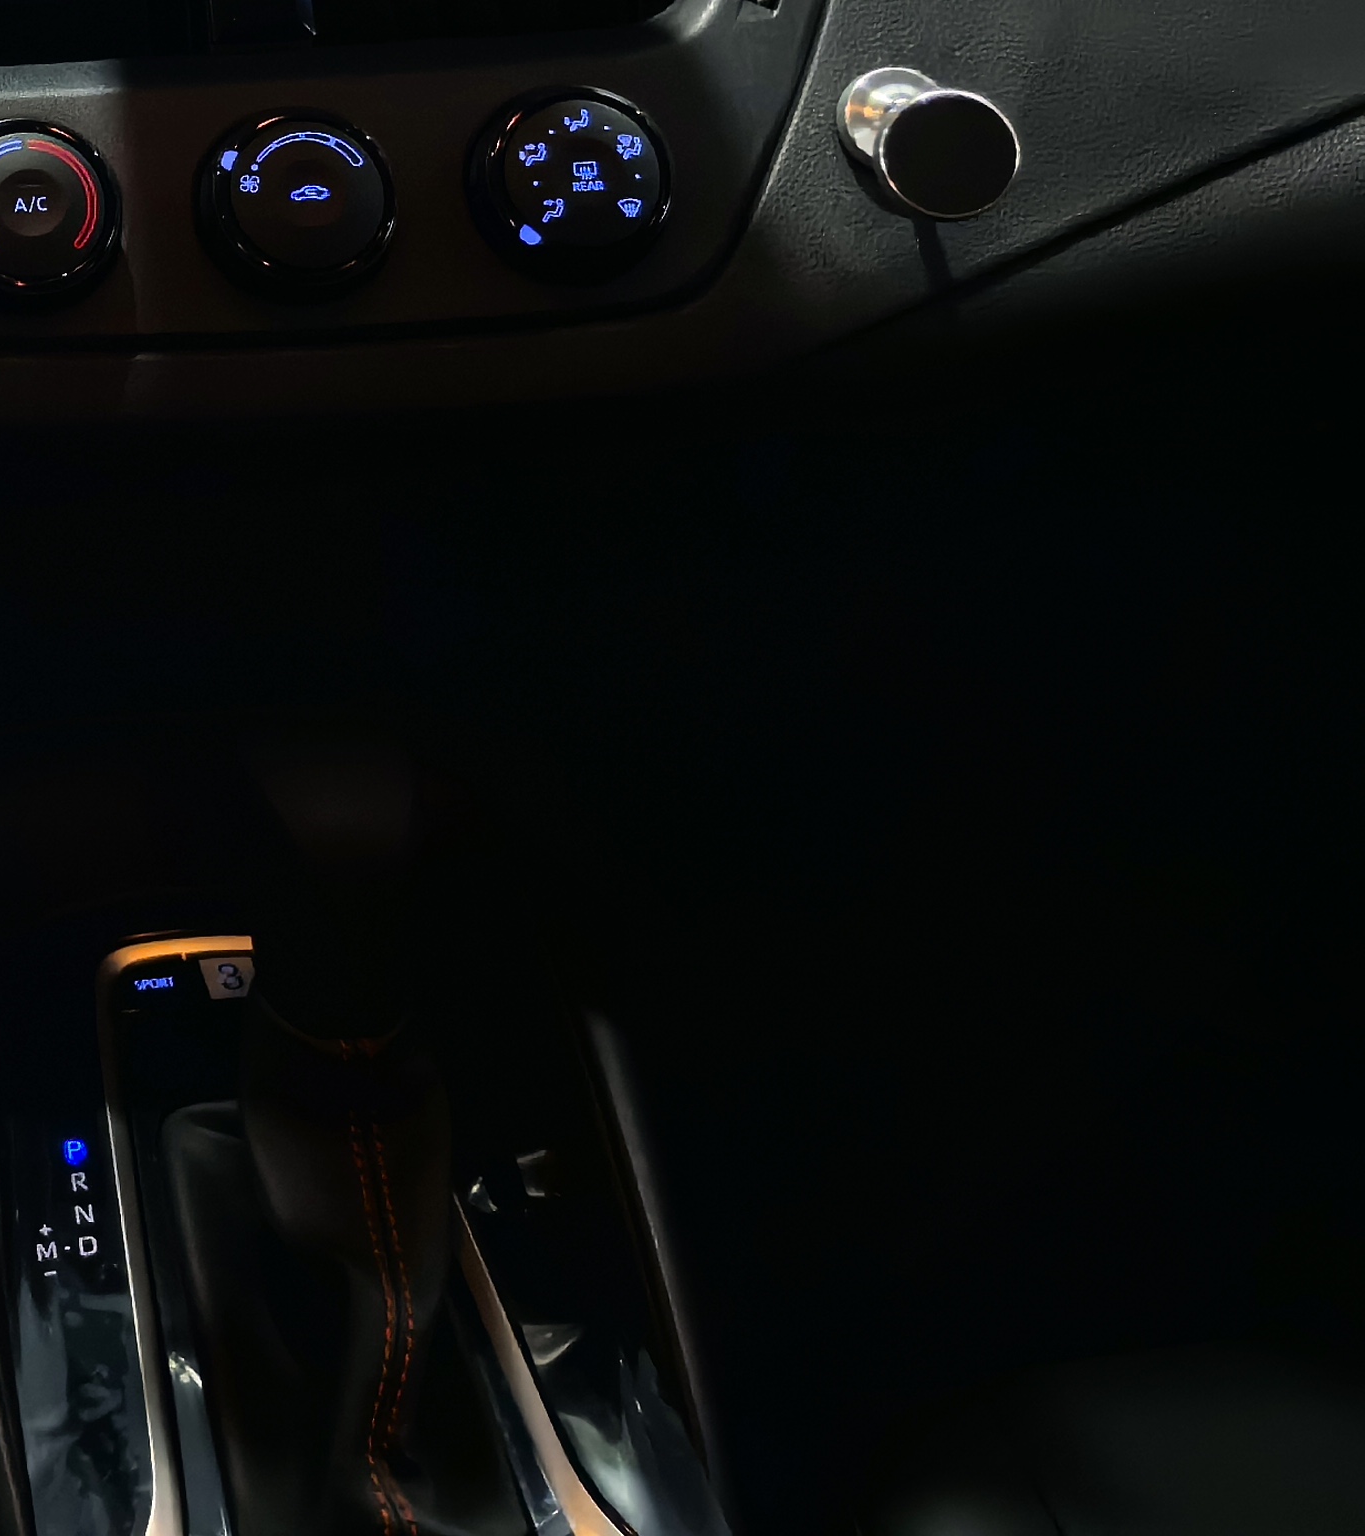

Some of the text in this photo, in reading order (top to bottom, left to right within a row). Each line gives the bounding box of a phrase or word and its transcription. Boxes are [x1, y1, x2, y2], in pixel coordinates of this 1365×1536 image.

[572, 180, 605, 193] REAR
[14, 196, 48, 213] A/C
[134, 977, 174, 991] SPORT
[70, 1172, 89, 1192] R
[74, 1204, 95, 1224] N
[36, 1235, 98, 1262] M D
